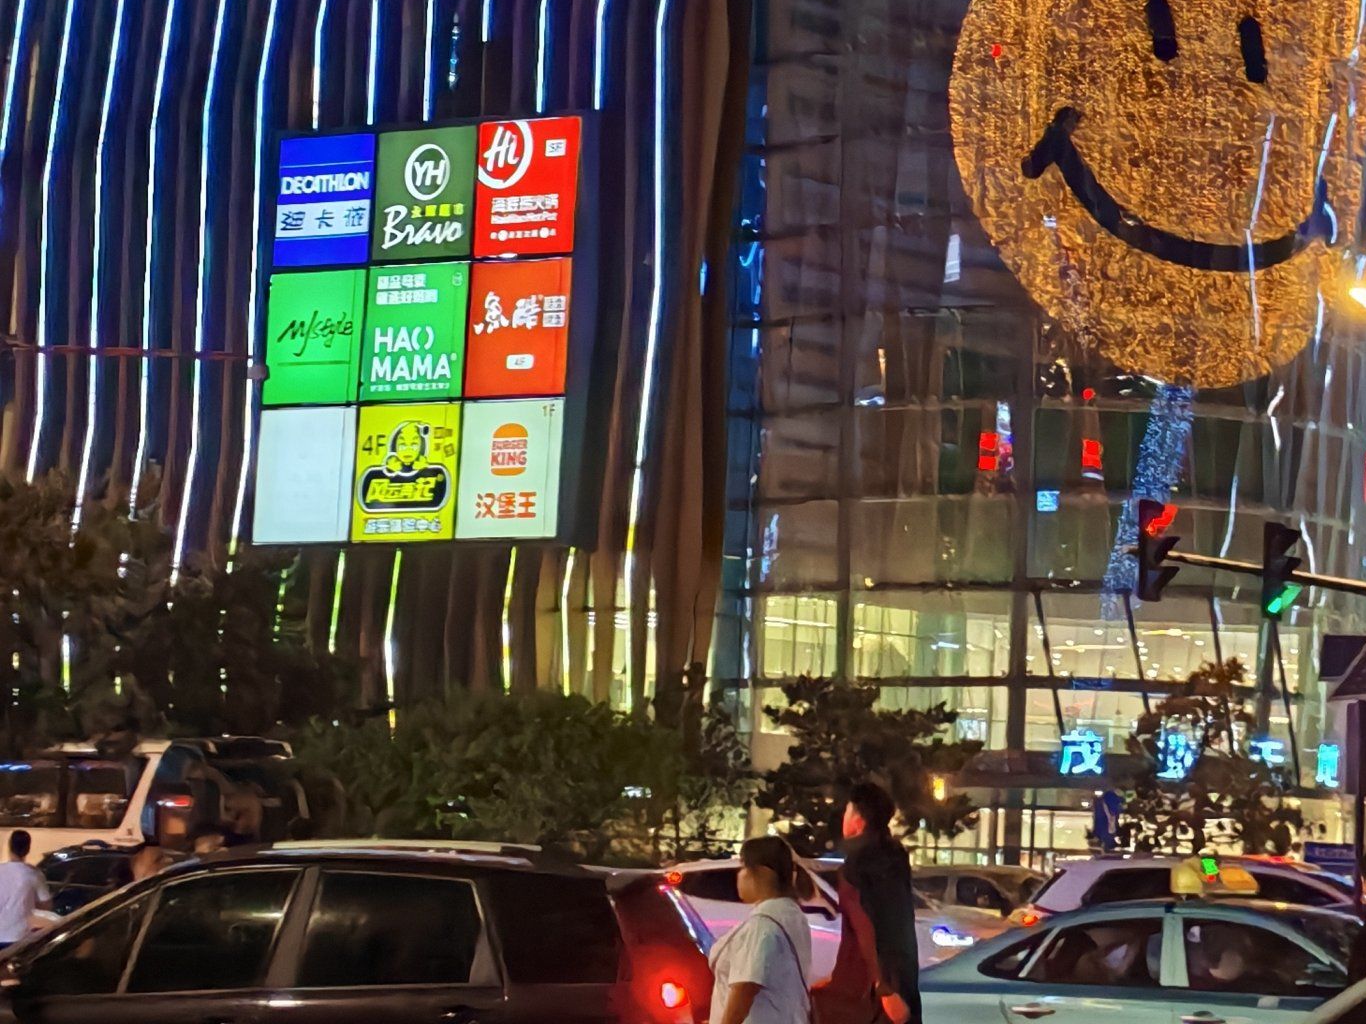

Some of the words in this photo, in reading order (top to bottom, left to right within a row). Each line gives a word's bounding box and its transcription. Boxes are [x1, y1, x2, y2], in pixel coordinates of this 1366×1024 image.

[281, 171, 370, 195] DECATHLON
[413, 159, 446, 187] YH
[381, 204, 464, 250] Bravo
[374, 325, 434, 353] HAO
[370, 353, 452, 382] MAMA
[362, 434, 387, 456] 4F
[490, 451, 527, 467] KING
[475, 491, 537, 519] 汉堡王
